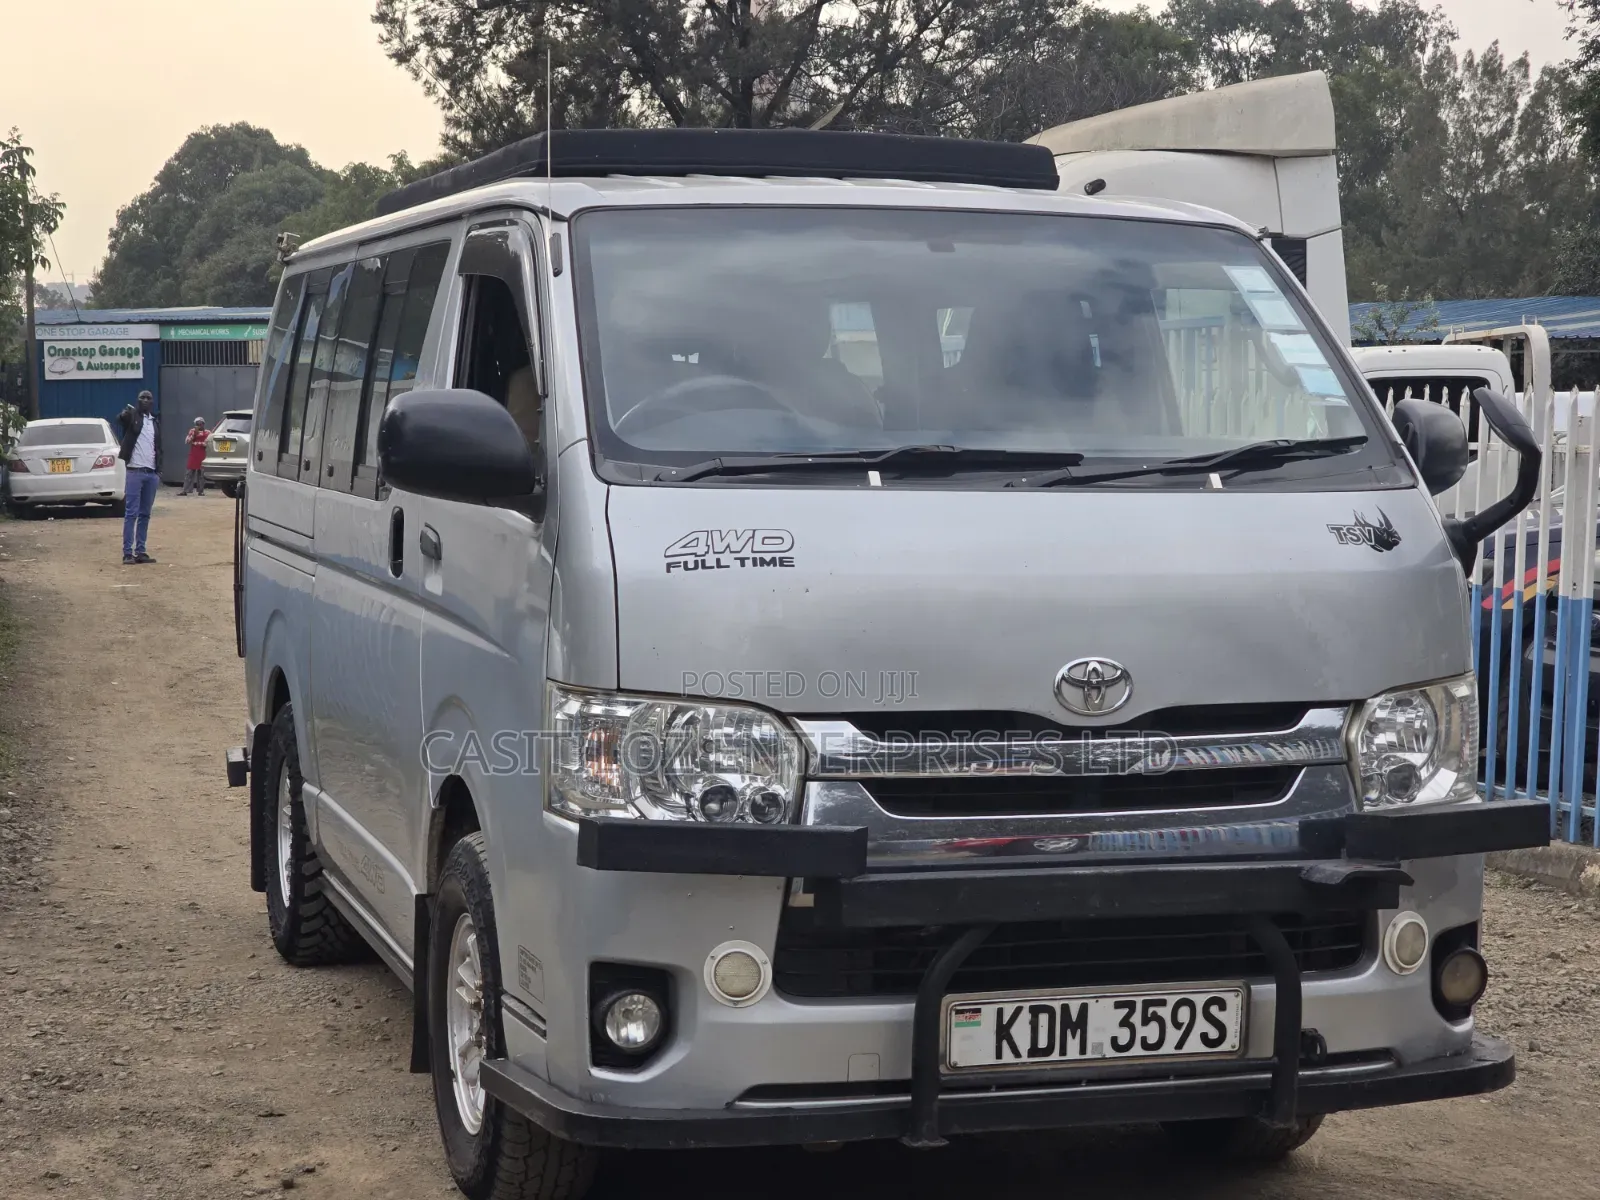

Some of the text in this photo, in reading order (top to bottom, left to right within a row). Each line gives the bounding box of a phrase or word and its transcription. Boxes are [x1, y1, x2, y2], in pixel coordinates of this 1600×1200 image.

[35, 327, 129, 337] ONE STOP GARAGE
[47, 344, 140, 359] Onestop Garage
[76, 360, 141, 373] & Autospares
[664, 528, 795, 558] 4WD
[1326, 523, 1376, 546] TSV
[665, 556, 796, 574] FULL TIME
[995, 1002, 1089, 1061] KDM
[1110, 995, 1228, 1054] 359S
